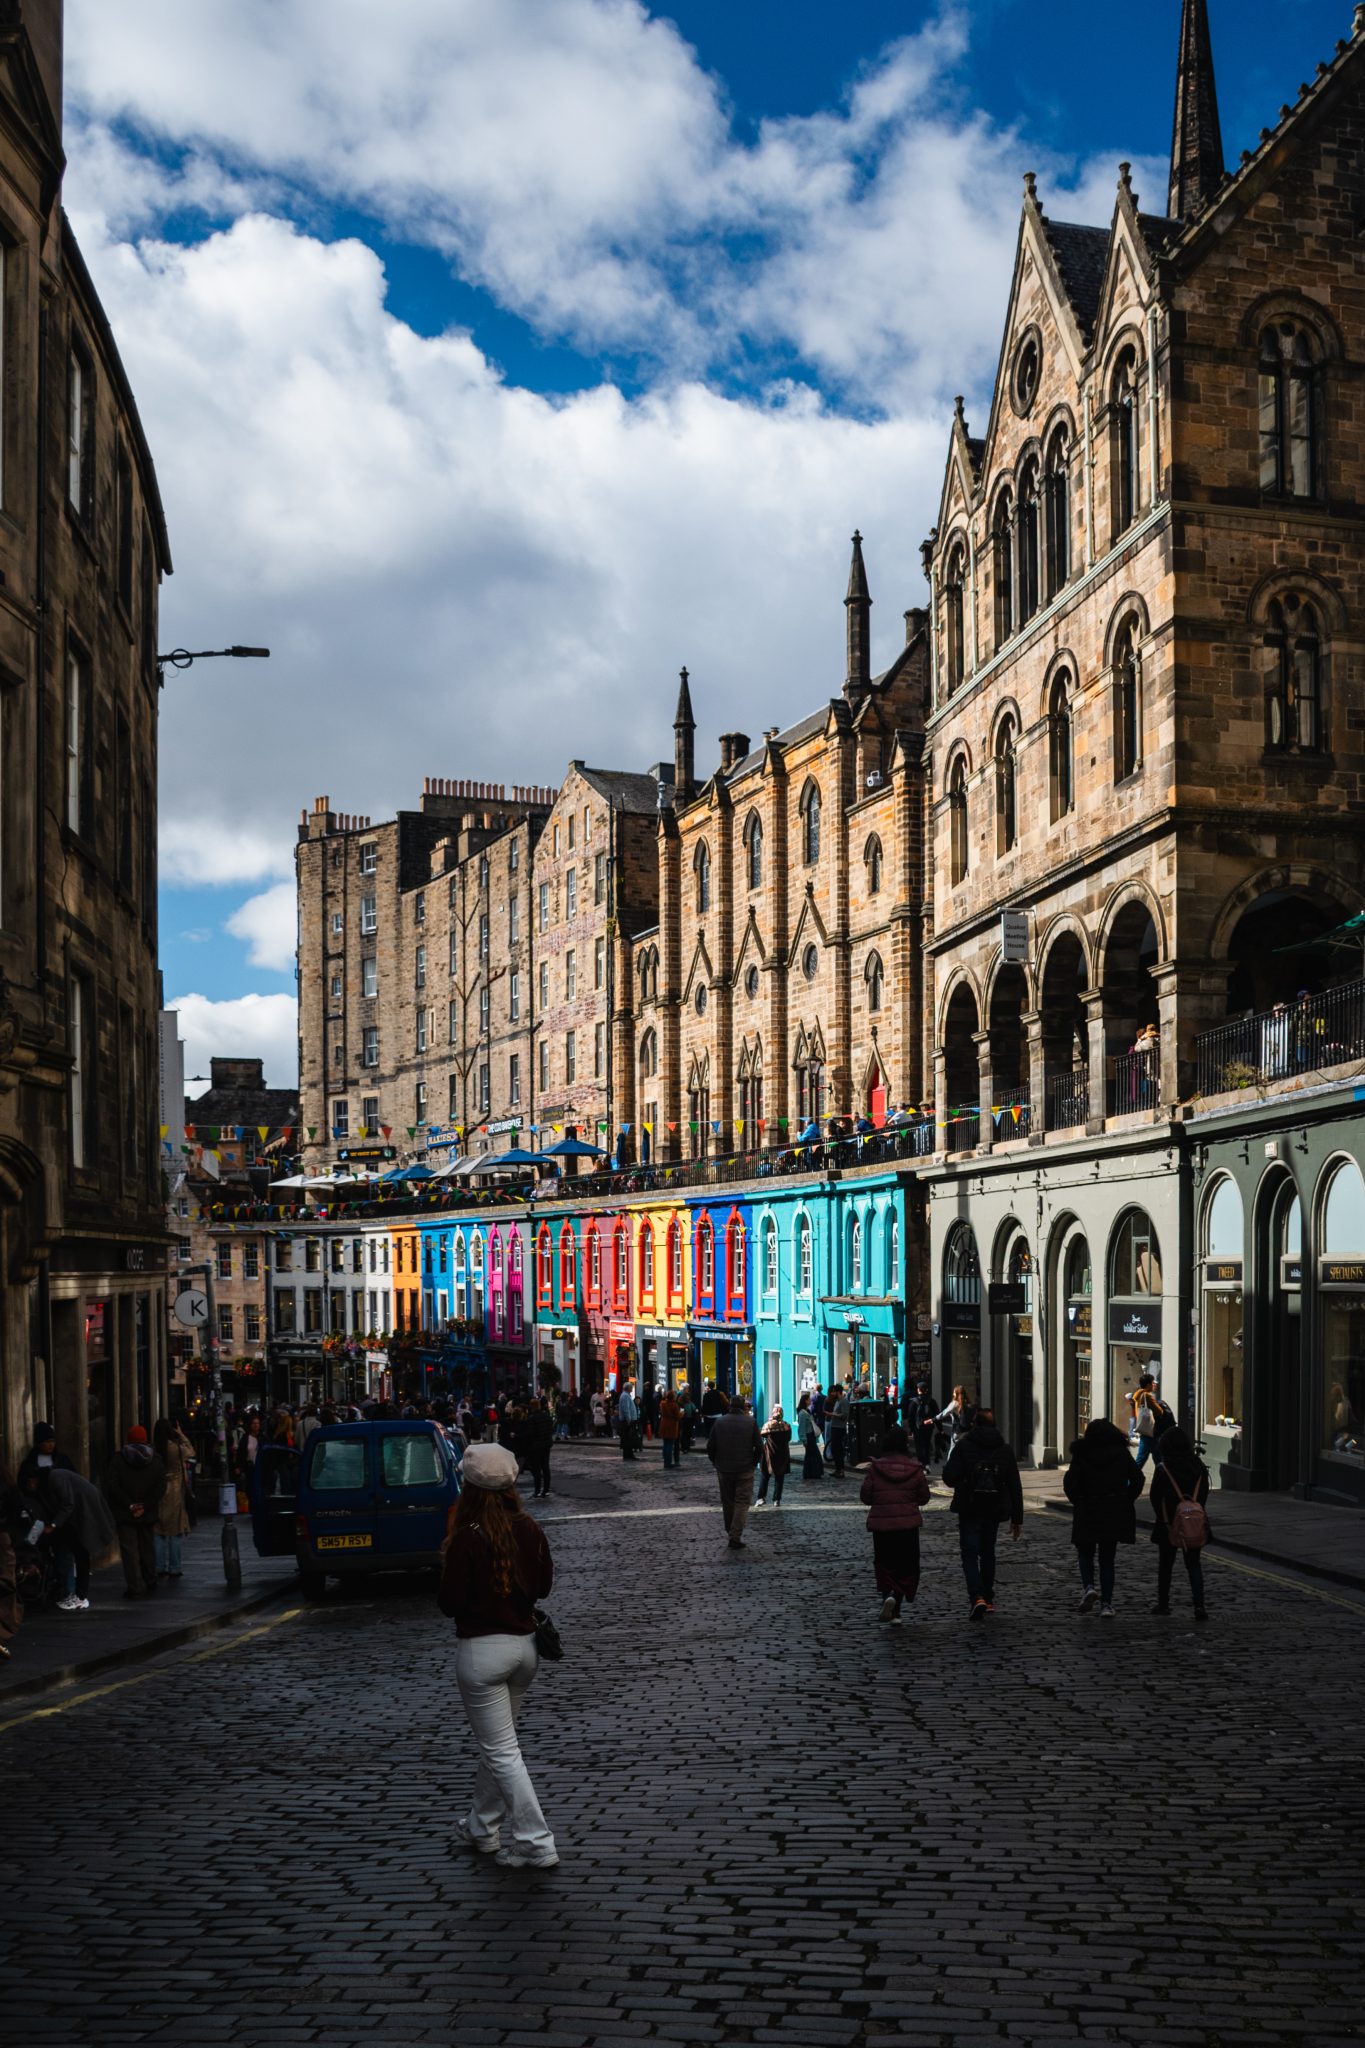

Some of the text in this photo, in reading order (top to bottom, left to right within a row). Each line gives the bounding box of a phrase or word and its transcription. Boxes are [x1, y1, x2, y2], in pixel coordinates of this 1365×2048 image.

[1218, 1266, 1235, 1279] TWEED
[1329, 1266, 1364, 1280] SPECIALISTS
[191, 1300, 205, 1316] K
[321, 1535, 368, 1547] SM57 RSY
